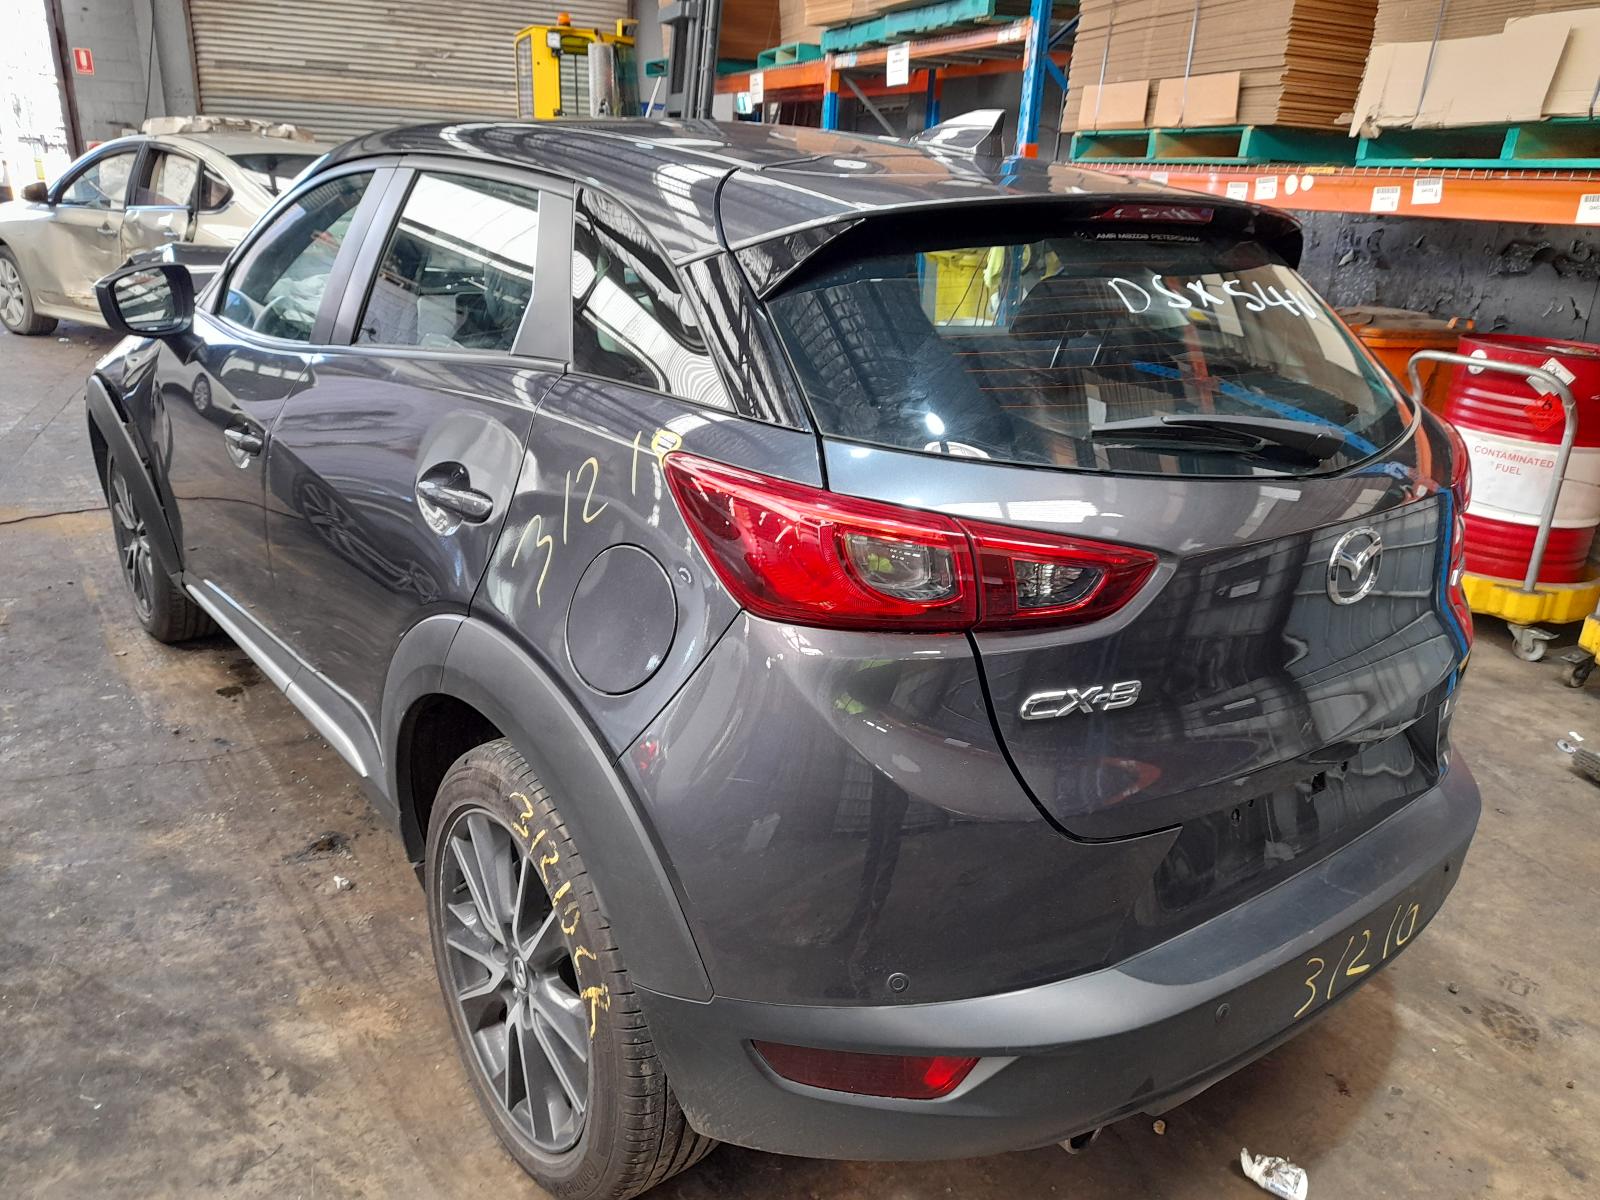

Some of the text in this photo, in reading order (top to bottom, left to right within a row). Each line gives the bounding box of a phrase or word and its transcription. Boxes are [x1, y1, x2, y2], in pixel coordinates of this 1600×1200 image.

[1474, 445, 1555, 469] CONTAMINATED
[1495, 463, 1521, 476] FUEL
[1020, 680, 1142, 720] CX-3
